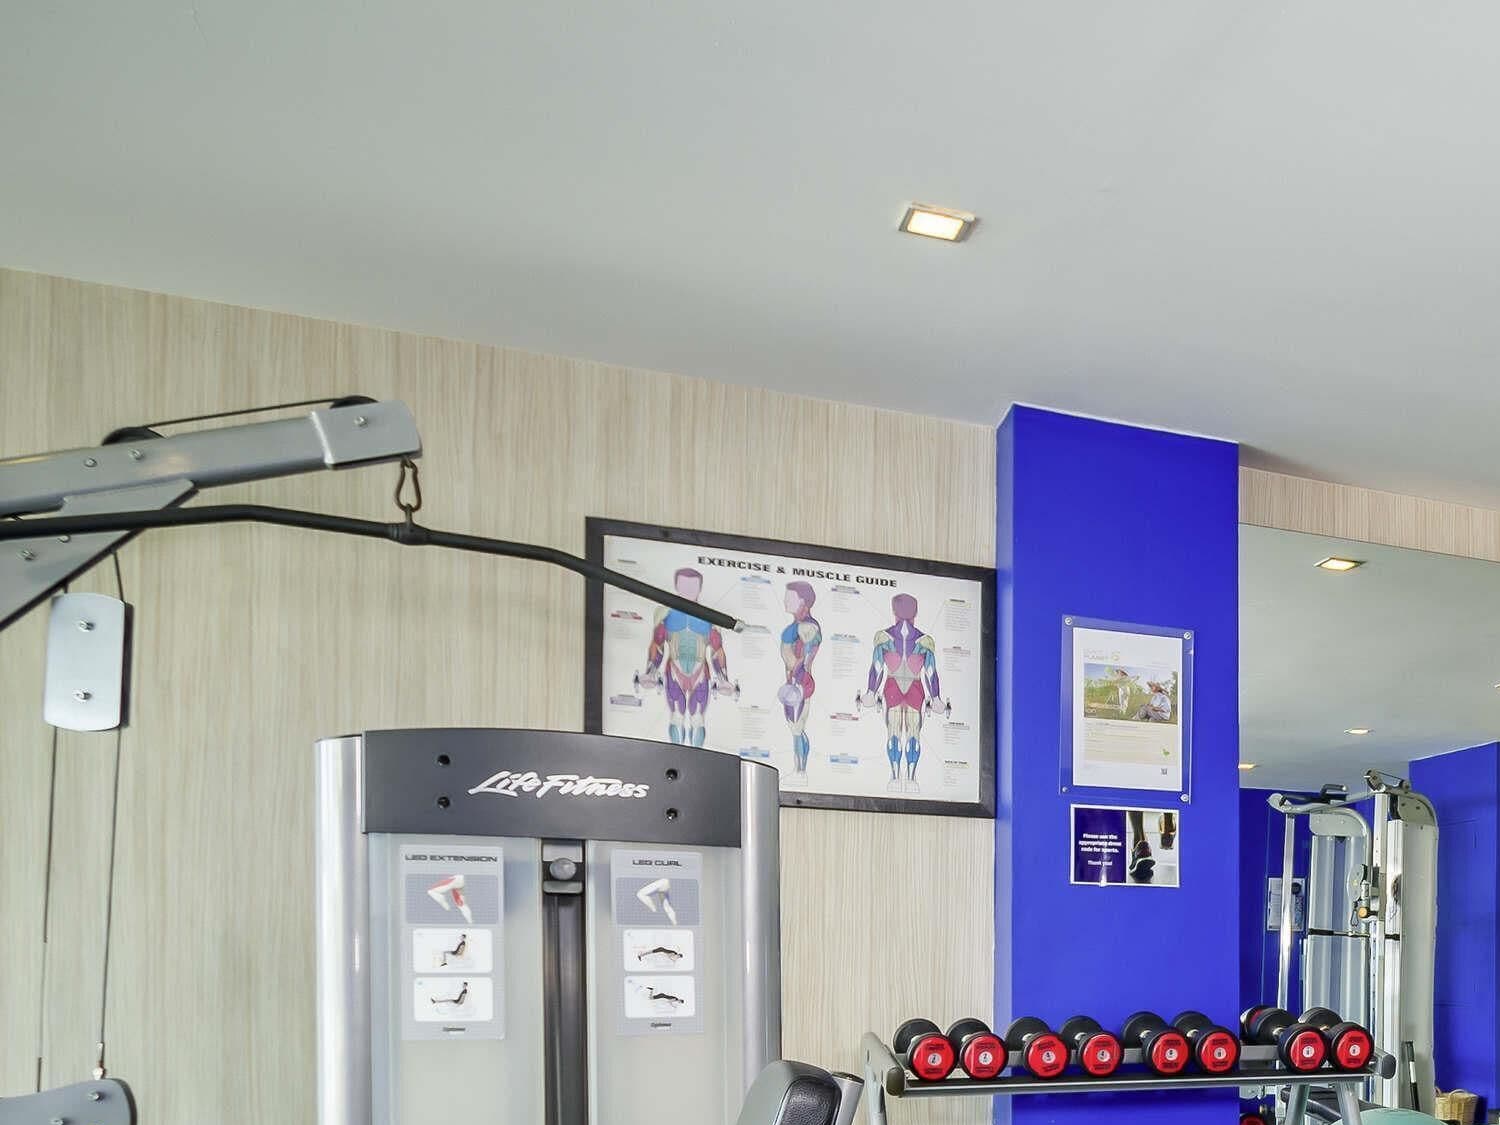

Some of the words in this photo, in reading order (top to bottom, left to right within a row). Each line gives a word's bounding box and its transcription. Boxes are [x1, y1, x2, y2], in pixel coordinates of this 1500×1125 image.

[698, 556, 771, 573] EXERCISE
[776, 563, 786, 574] &
[793, 568, 851, 582] MUSCLE
[856, 575, 897, 588] GUIDE
[468, 770, 542, 797] Life
[536, 774, 650, 798] Fitness
[430, 854, 498, 862] EXTENSION
